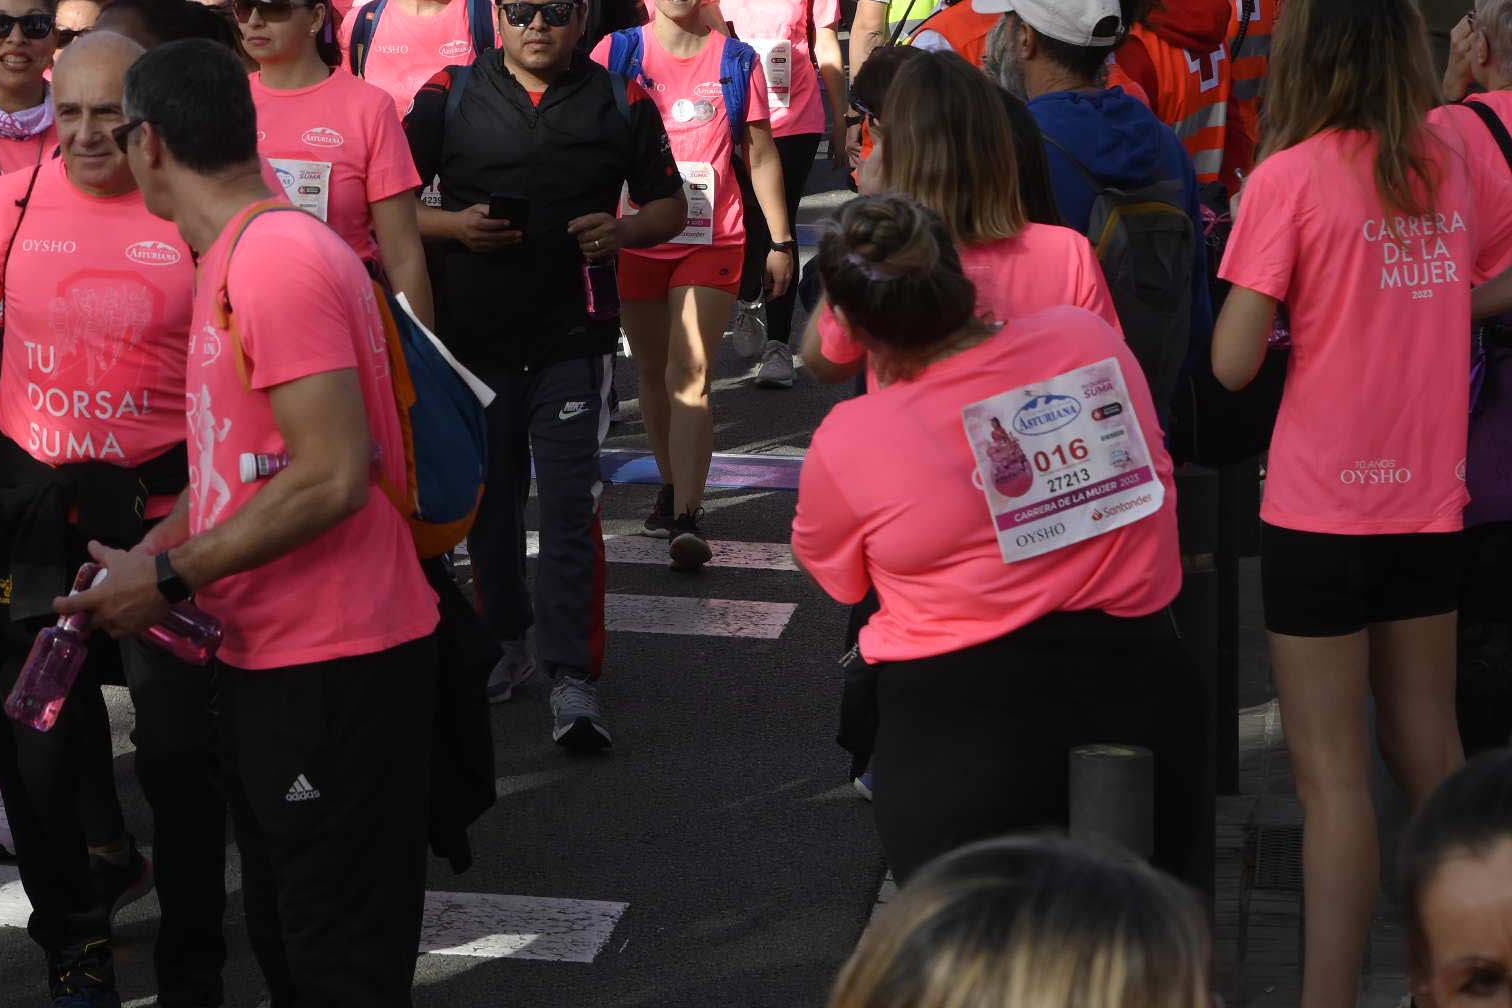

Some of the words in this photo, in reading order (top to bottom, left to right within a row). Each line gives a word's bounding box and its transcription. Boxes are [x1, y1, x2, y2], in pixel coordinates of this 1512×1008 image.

[1363, 211, 1467, 242] CARRERA
[22, 239, 77, 254] OYSHO
[130, 248, 177, 261] ASTURIANA
[1383, 240, 1412, 265] DE
[1421, 238, 1451, 259] LA
[1380, 261, 1460, 289] MUJER
[1411, 289, 1433, 299] 2023
[24, 342, 55, 373] TU
[28, 382, 153, 420] DORSAL
[563, 401, 586, 412] NIKE
[1018, 404, 1077, 431] ASTURIANA
[1083, 383, 1115, 399] SUMA
[28, 422, 124, 459] SUMA
[1033, 438, 1089, 472] 016
[1047, 468, 1091, 493] 27213
[1340, 468, 1412, 484] OYSHO
[1014, 501, 1057, 522] CARRERA
[1058, 495, 1072, 507] DE
[1072, 491, 1085, 503] LA
[1085, 481, 1117, 498] MUJER
[1016, 522, 1066, 548] OYSHO
[1103, 493, 1153, 518] Santander
[286, 790, 321, 801] adidas
